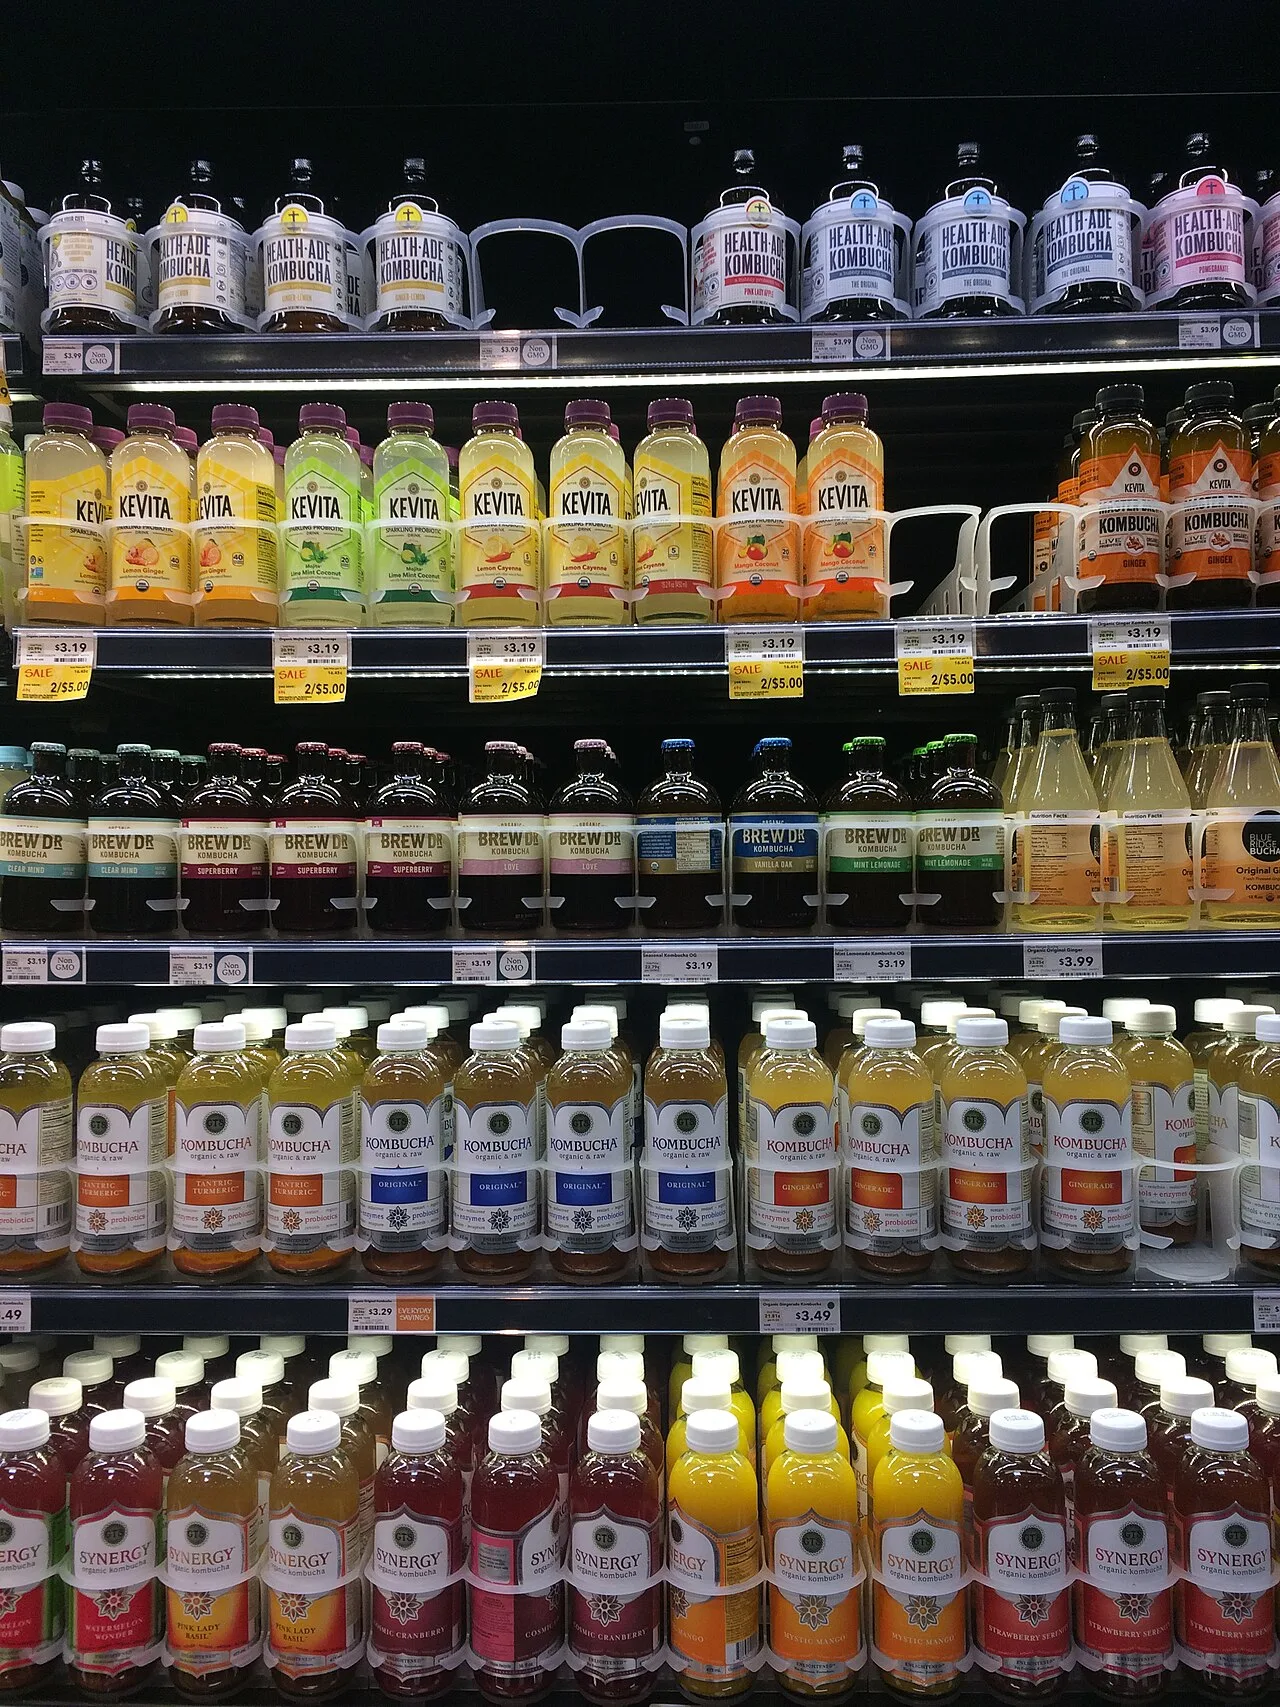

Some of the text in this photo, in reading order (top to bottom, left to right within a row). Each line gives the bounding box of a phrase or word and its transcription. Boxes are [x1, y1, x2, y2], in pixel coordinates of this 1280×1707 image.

[1046, 231, 1112, 261] KOMBUCHA
[1175, 232, 1242, 259] KOMBUCHA
[829, 245, 892, 273] KOMBUCHA
[267, 259, 332, 285] KOMBUCHA
[381, 259, 444, 283] KOMBUCHA
[860, 343, 879, 351] GMO
[1124, 483, 1145, 493] KEVITA
[1209, 480, 1231, 490] KEVITA
[562, 489, 612, 516] KEVITA
[732, 487, 782, 513] KEVITA
[819, 484, 868, 510] KEVITA
[120, 494, 172, 519] KEVITA
[291, 495, 341, 519] KEVITA
[390, 497, 440, 519] KEVITA
[474, 491, 522, 516] KEVITA
[1099, 516, 1159, 534] KOMBUCHA
[1185, 512, 1249, 531] KOMBUCHA
[820, 558, 865, 567] Mango Coconut
[1123, 559, 1146, 568] GINGER
[1208, 555, 1232, 564] GINGER
[1127, 627, 1160, 638] $3.19
[762, 638, 794, 648] $3.19
[932, 633, 965, 644] $3.19
[308, 643, 339, 653] $3.19
[504, 642, 535, 652] $3.19
[1098, 654, 1128, 665] SALE
[733, 664, 761, 675] SALE
[904, 660, 932, 671] SALE
[279, 669, 306, 679] SALE
[475, 668, 503, 679] SALE
[1126, 668, 1168, 681] 2/$5.00
[761, 677, 802, 690] 2/$5.00
[931, 673, 973, 686] 2/$5.00
[305, 683, 345, 695] 2/$5.00
[501, 680, 539, 693] 2/$5.00
[92, 834, 130, 849] BREW
[381, 833, 425, 849] BREW
[559, 831, 602, 846] BREW
[845, 828, 890, 844] BREW
[1249, 833, 1273, 841] BLUE
[100, 850, 140, 859] KOMBUCHA
[393, 850, 433, 858] KOMBUCHA
[570, 847, 610, 855] KOMBUCHA
[857, 845, 897, 853] KOMBUCHA
[582, 863, 598, 871] LOVE
[754, 860, 793, 868] VANILLA OAK
[869, 861, 900, 869] LEMONADE
[101, 866, 138, 874] CLEAR MIND
[393, 866, 433, 874] SUPERBERRY
[1236, 867, 1271, 876] Original
[55, 963, 75, 971] GMO
[685, 961, 712, 970] $3.19
[877, 959, 905, 968] $3.19
[1059, 956, 1094, 967] $3.99
[504, 963, 524, 972] GMO
[181, 1137, 251, 1153] KOMBUCHA
[365, 1136, 435, 1152] KOMBUCHA
[550, 1137, 617, 1151] KOMBUCHA
[652, 1136, 720, 1151] KOMBUCHA
[1054, 1135, 1127, 1150] KOMBUCHA
[375, 1151, 400, 1160] organic
[662, 1152, 689, 1160] organic
[1066, 1150, 1095, 1159] organic
[196, 1179, 233, 1187] TANTRIC
[1068, 1181, 1113, 1189] GINGERADE
[193, 1186, 235, 1195] TURMERIC
[304, 1213, 338, 1224] probiotics
[761, 1213, 790, 1223] enzymes
[368, 1308, 392, 1316] $3.29
[795, 1310, 831, 1321] $3.49
[80, 1542, 149, 1566] SYNERGY
[575, 1548, 641, 1569] SYNERGY
[1095, 1547, 1165, 1566] SYNERGY
[1197, 1547, 1267, 1567] SYNERGY
[779, 1553, 847, 1573] SYNERGY
[995, 1550, 1062, 1570] SYNERGY
[577, 1566, 637, 1579] organic kombucha
[998, 1567, 1061, 1579] organic kombucha
[1098, 1564, 1163, 1575] organic kombucha
[781, 1570, 844, 1582] organic kombucha
[85, 1617, 144, 1632] WATERMELON
[275, 1623, 316, 1634] PINK LADY
[1088, 1620, 1141, 1638] STRAWBERRY
[95, 1630, 134, 1640] WONDER
[283, 1634, 304, 1643] BASIL
[597, 1628, 647, 1641] CRANBERRY
[783, 1631, 846, 1645] MYSTIC MANGO
[988, 1625, 1040, 1642] STRAWBERRY
